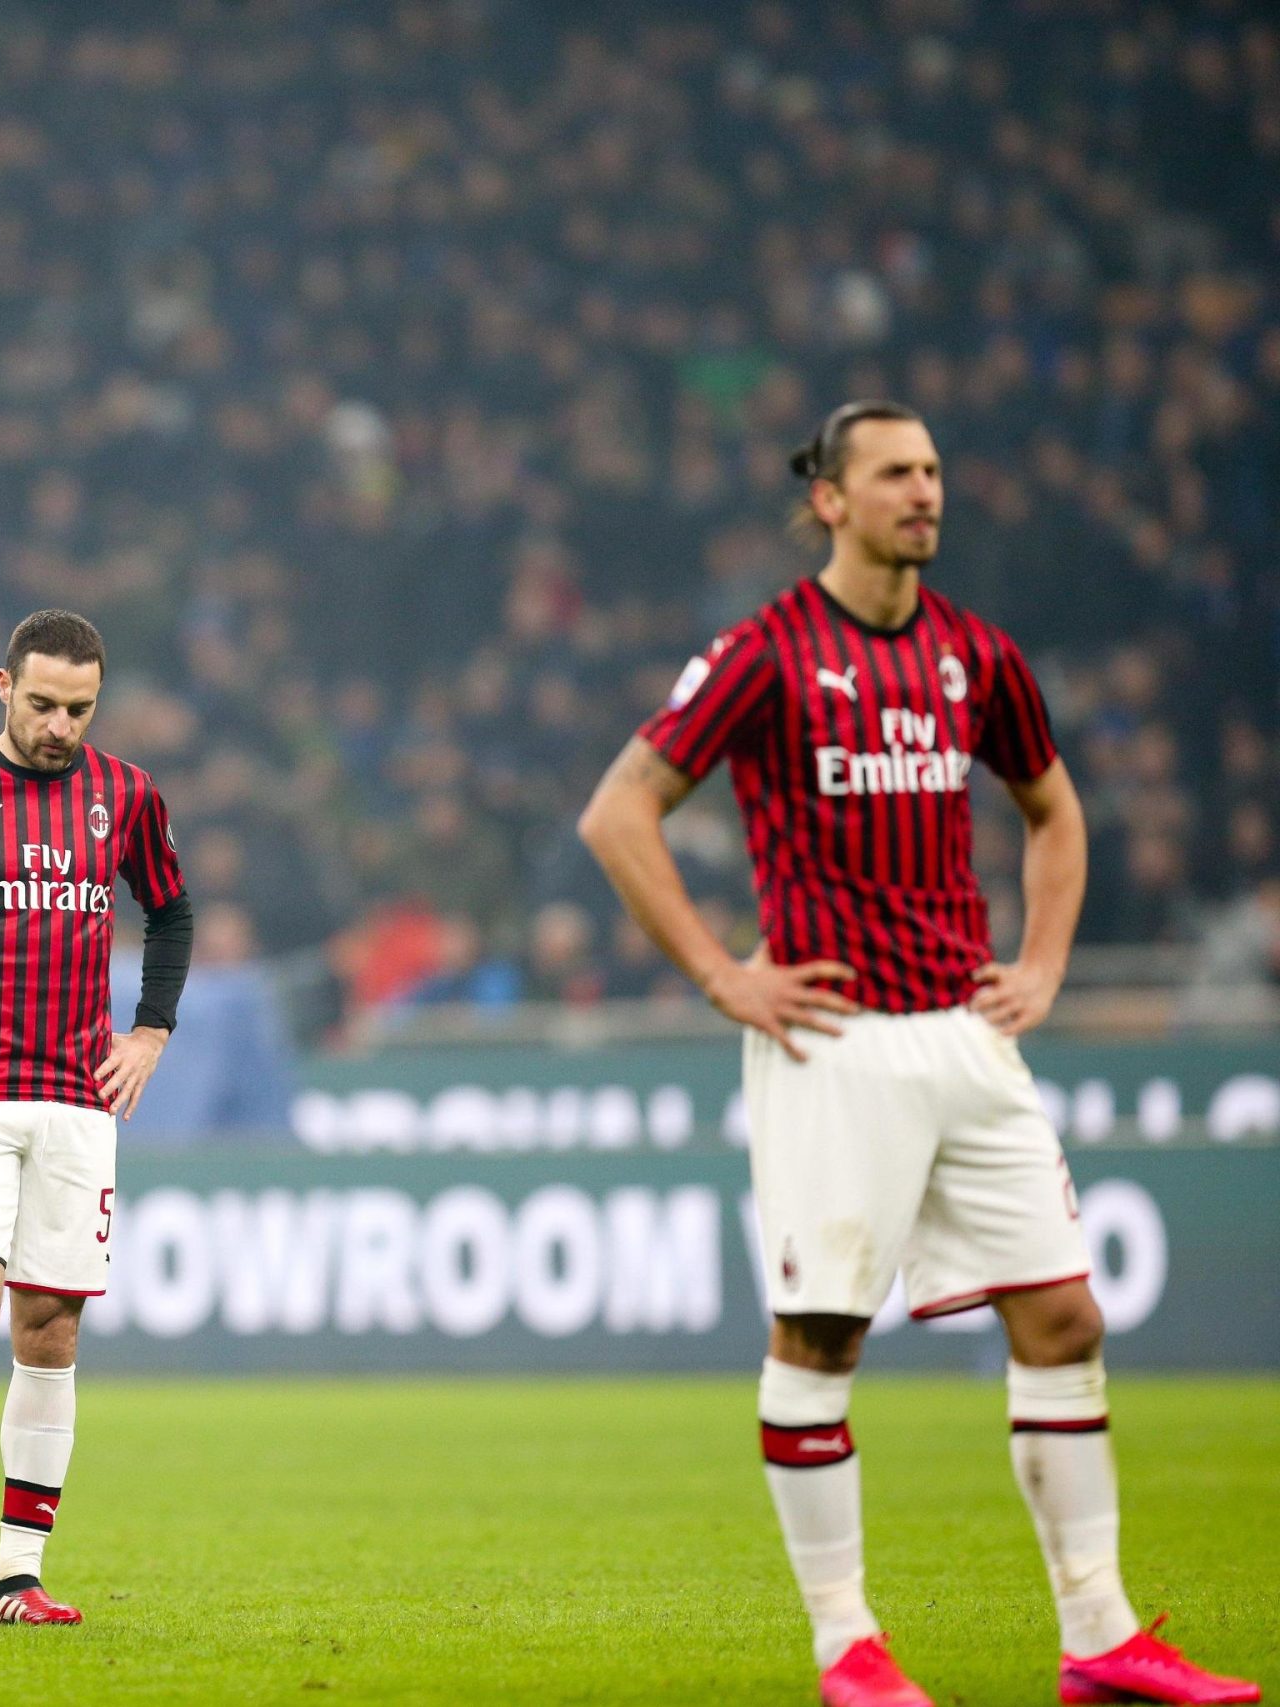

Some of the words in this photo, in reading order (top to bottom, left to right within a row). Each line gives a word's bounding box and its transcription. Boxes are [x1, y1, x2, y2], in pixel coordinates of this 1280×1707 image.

[880, 707, 936, 751] Fly
[815, 741, 971, 796] Emirat
[22, 843, 72, 875] Fly
[96, 1188, 114, 1243] 5
